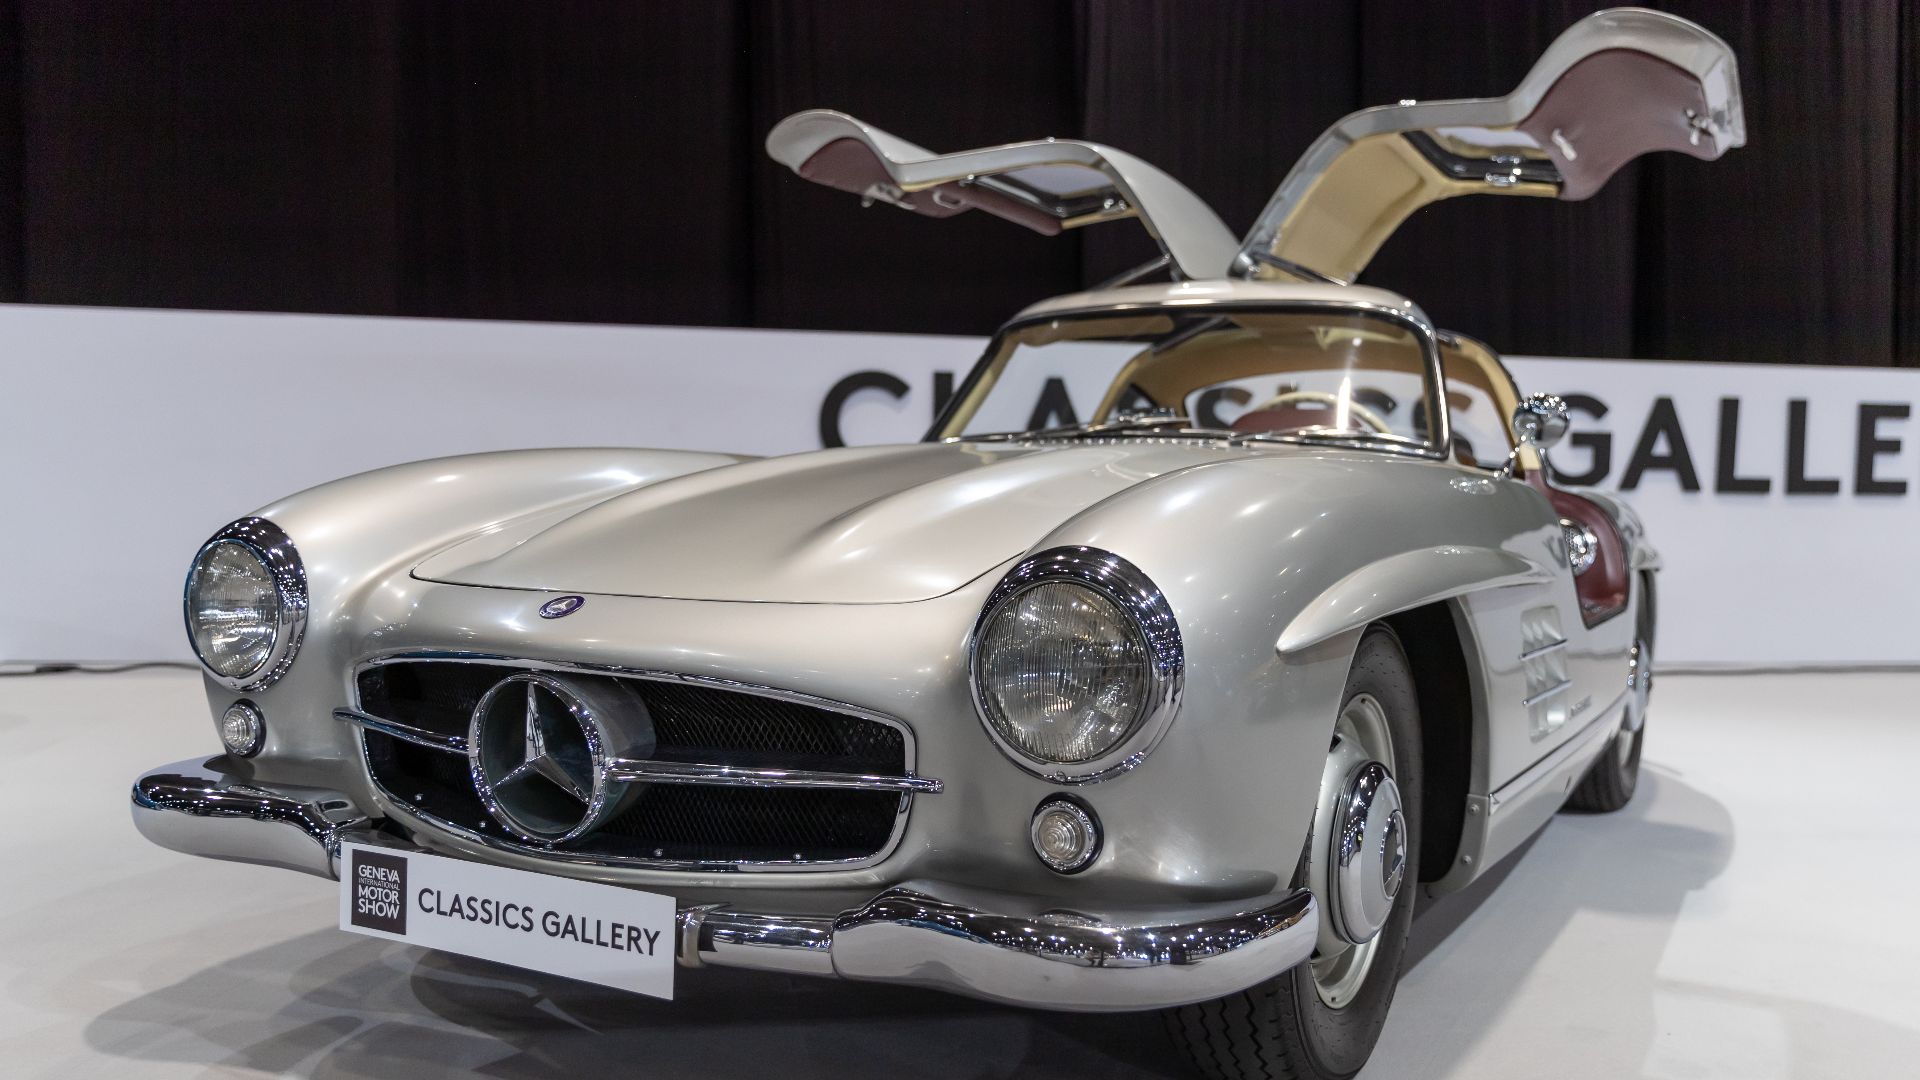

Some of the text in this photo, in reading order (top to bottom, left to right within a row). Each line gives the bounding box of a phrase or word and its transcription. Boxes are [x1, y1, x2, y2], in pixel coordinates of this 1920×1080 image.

[1547, 391, 1911, 496] GALLE
[358, 864, 400, 884] GENEVA
[358, 877, 400, 891] INTERNATIONAL
[358, 884, 400, 905] MOTOR
[358, 897, 400, 920] SHOW
[418, 887, 661, 957] CLASSICS GALLERY
